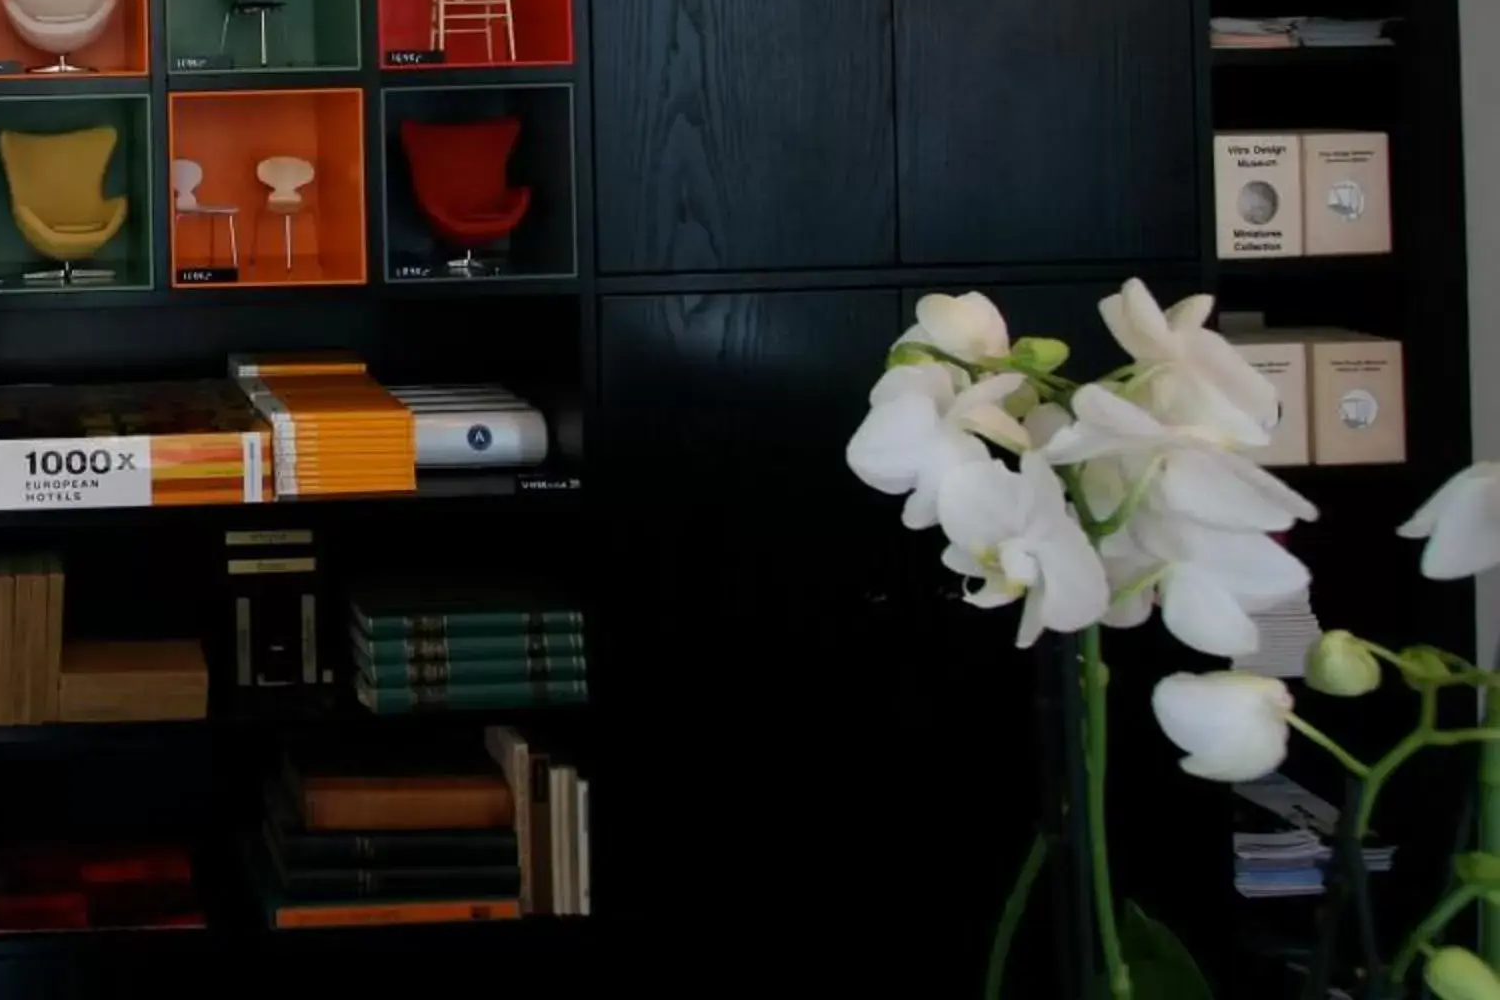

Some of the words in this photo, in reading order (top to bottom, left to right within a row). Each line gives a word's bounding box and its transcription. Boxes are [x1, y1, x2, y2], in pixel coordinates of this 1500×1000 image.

[1254, 145, 1287, 156] Design
[25, 479, 99, 490] EUROPEAN
[25, 491, 82, 502] HOTELS
